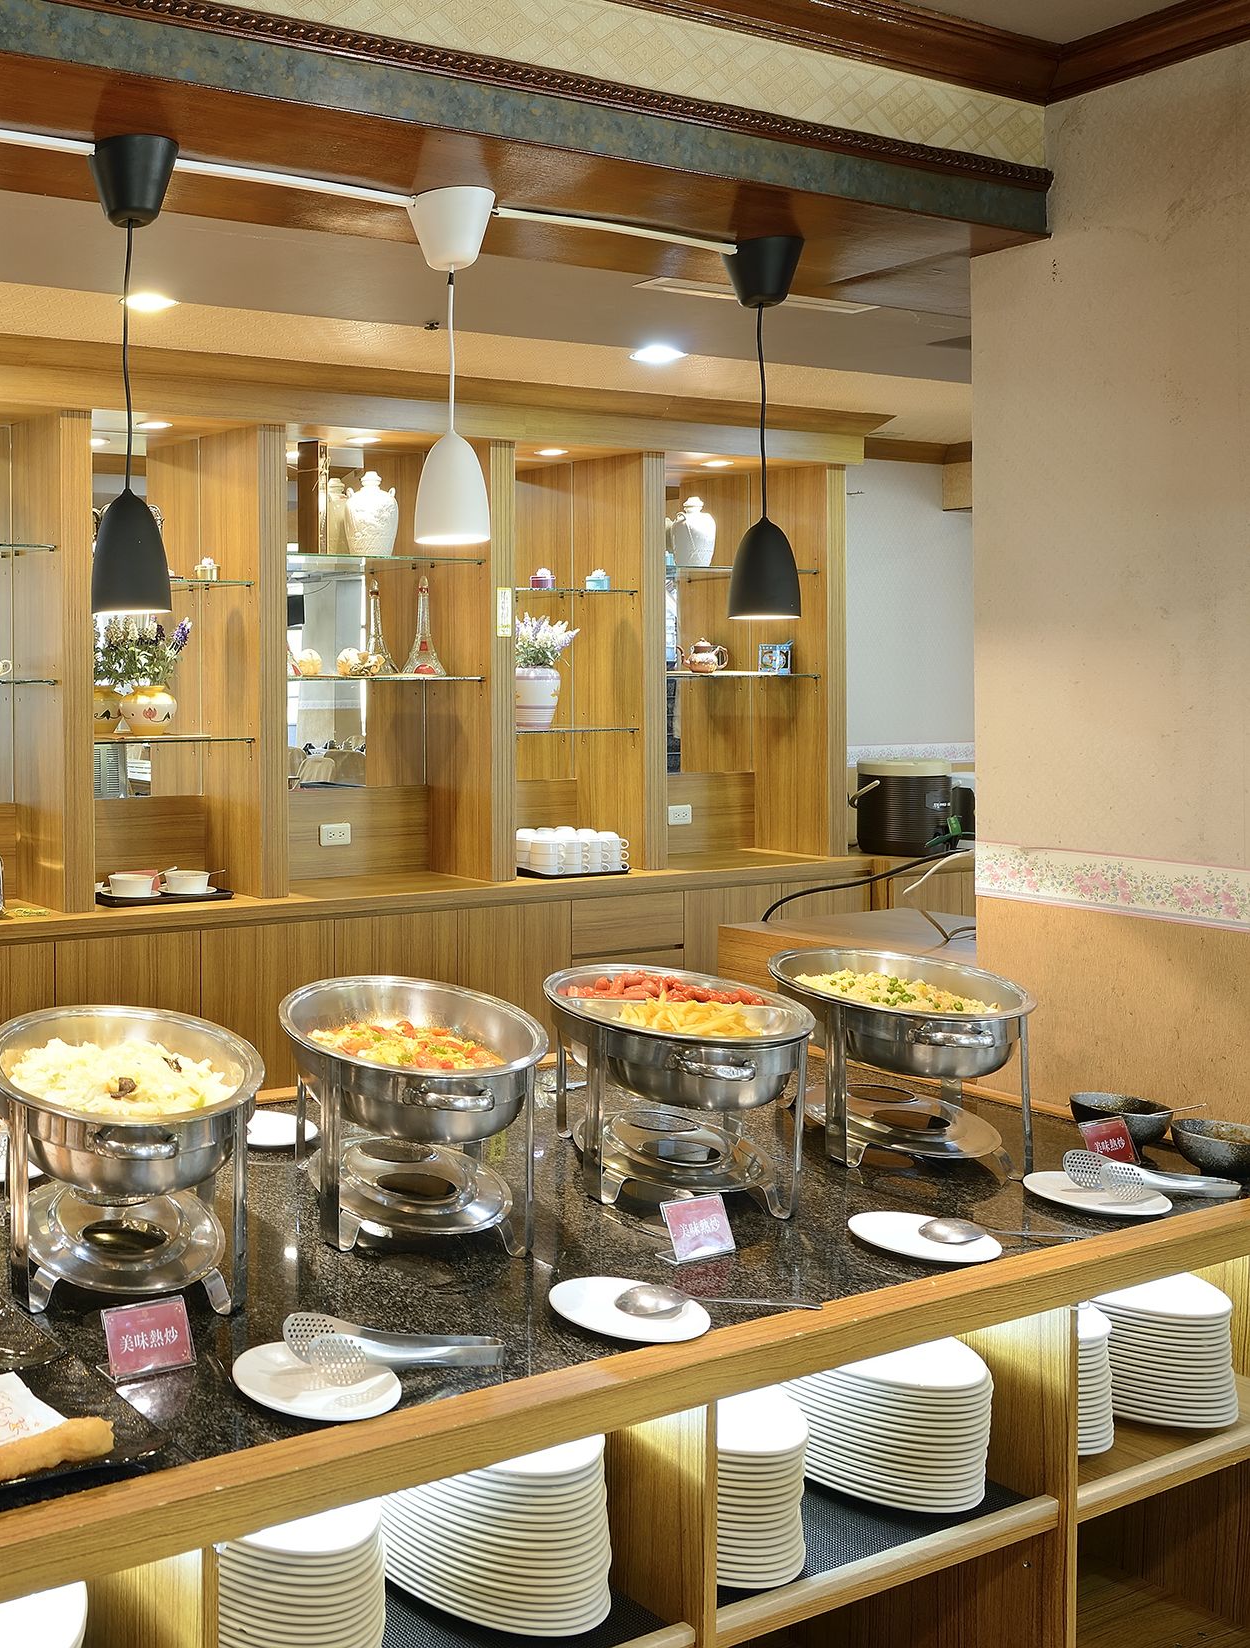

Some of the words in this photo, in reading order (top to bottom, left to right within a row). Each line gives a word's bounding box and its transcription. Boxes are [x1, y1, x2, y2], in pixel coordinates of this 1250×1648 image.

[678, 1216, 720, 1238] 美味熱炒
[119, 1326, 179, 1354] 美味熱炒
